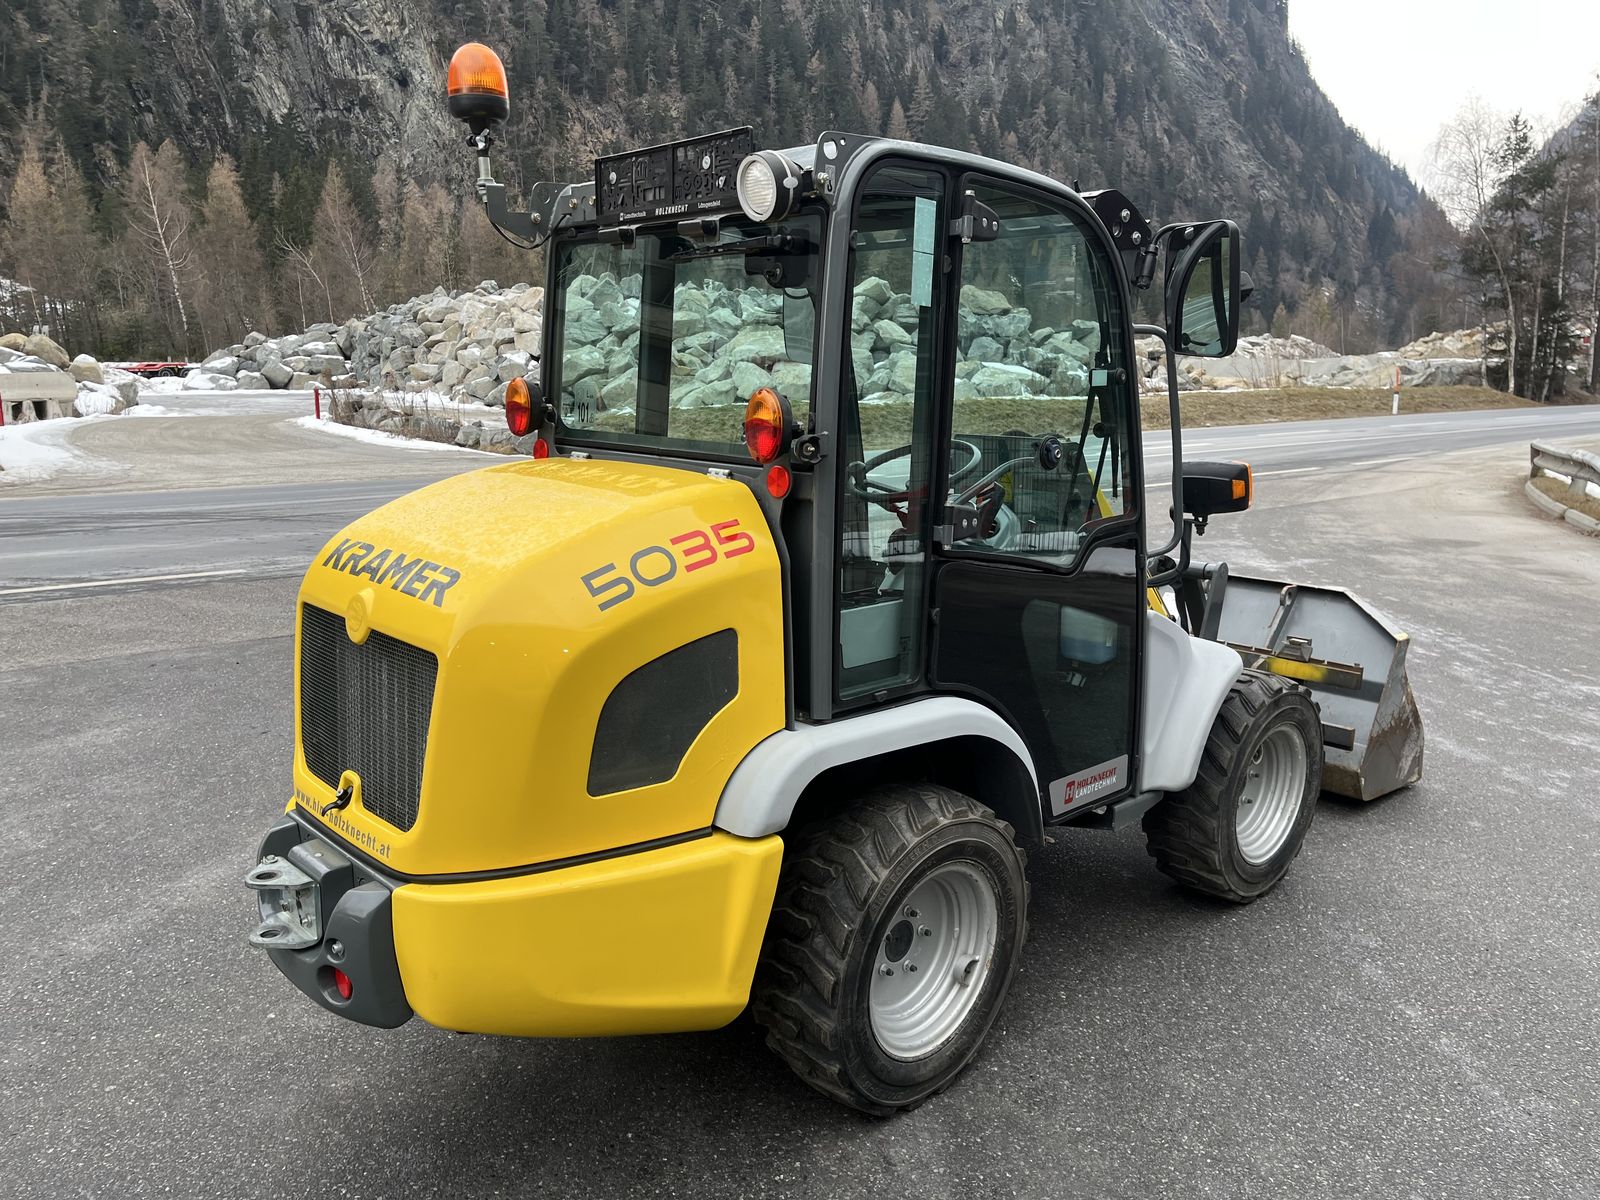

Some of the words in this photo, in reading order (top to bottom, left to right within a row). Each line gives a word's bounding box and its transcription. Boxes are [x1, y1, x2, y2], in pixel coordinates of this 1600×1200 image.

[655, 204, 688, 216] HOLZKNECHT
[578, 402, 589, 423] 101
[322, 538, 462, 608] KRAMER
[580, 518, 755, 612] 5035
[1075, 776, 1117, 798] LANDTECHNIK
[1076, 767, 1117, 789] HOLZKNECHT
